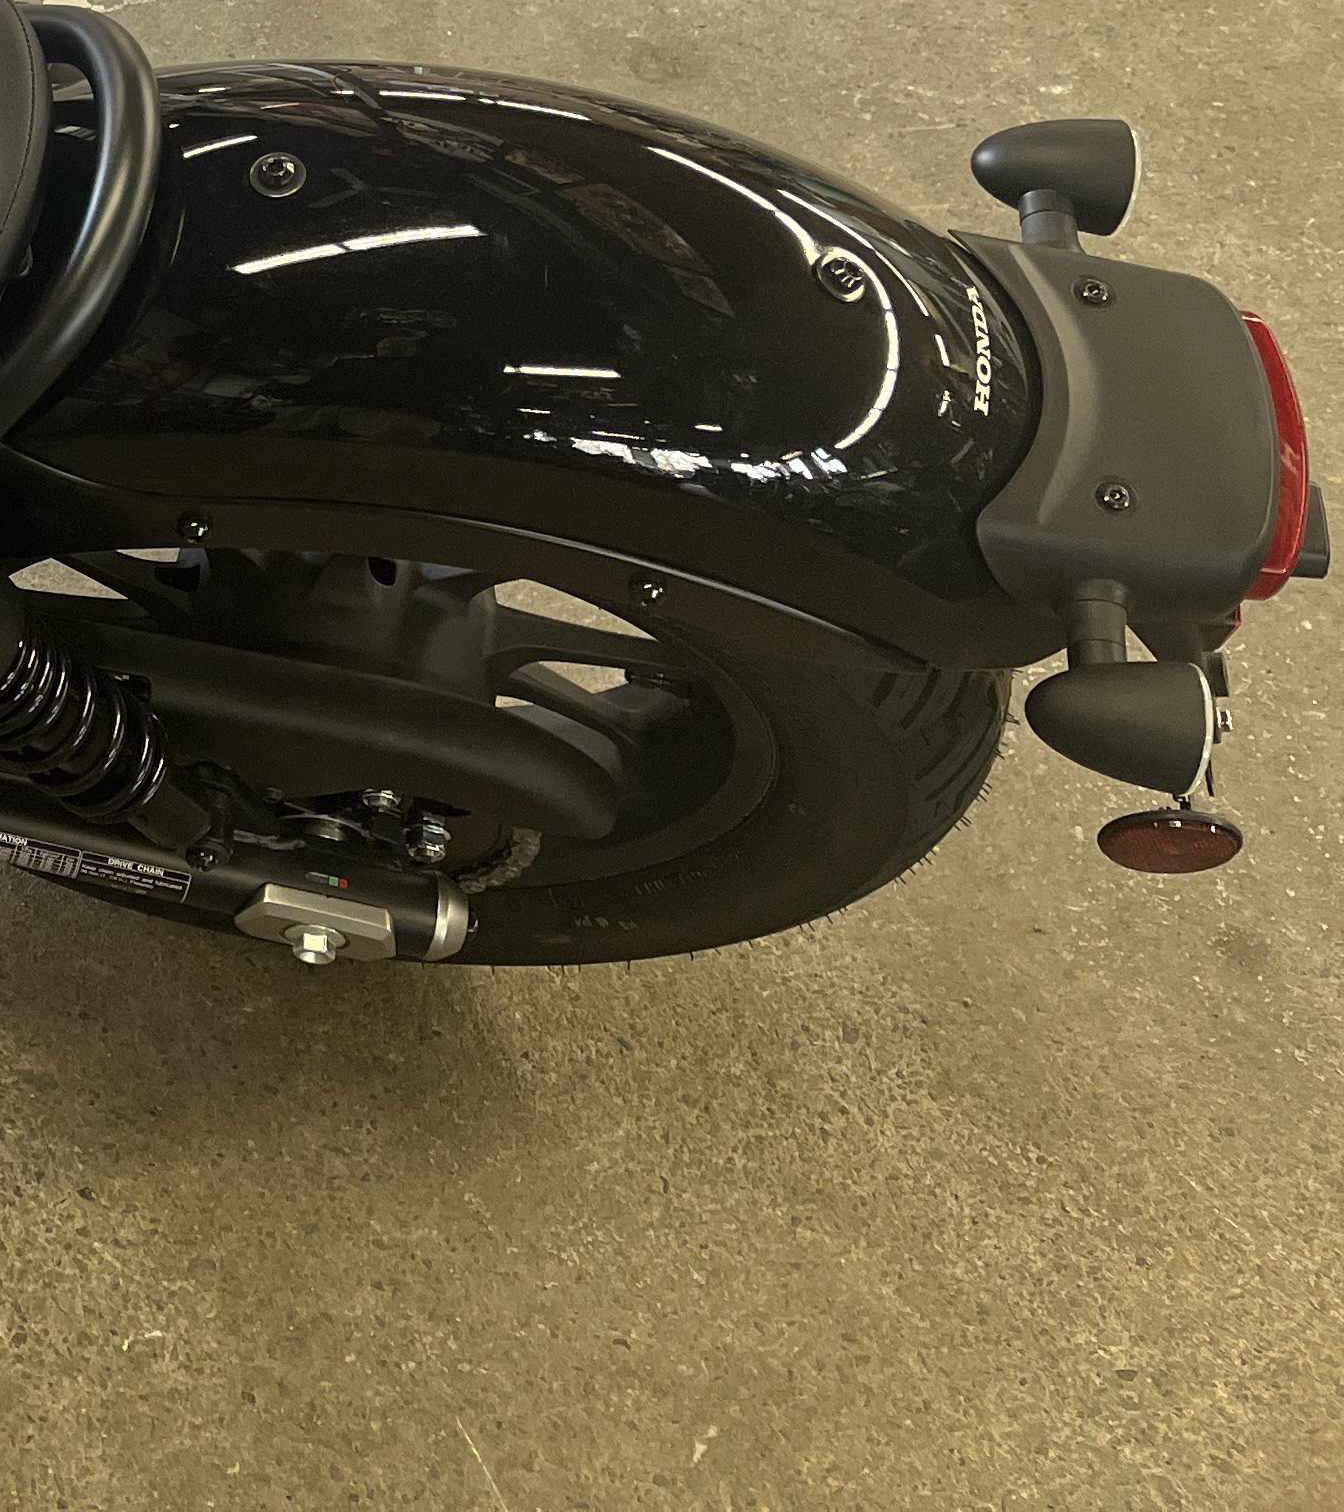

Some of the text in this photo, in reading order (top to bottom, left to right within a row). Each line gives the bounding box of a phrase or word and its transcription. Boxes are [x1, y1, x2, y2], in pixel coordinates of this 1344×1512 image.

[966, 285, 991, 416] HONDA
[107, 857, 164, 876] DRIVE CHAIN
